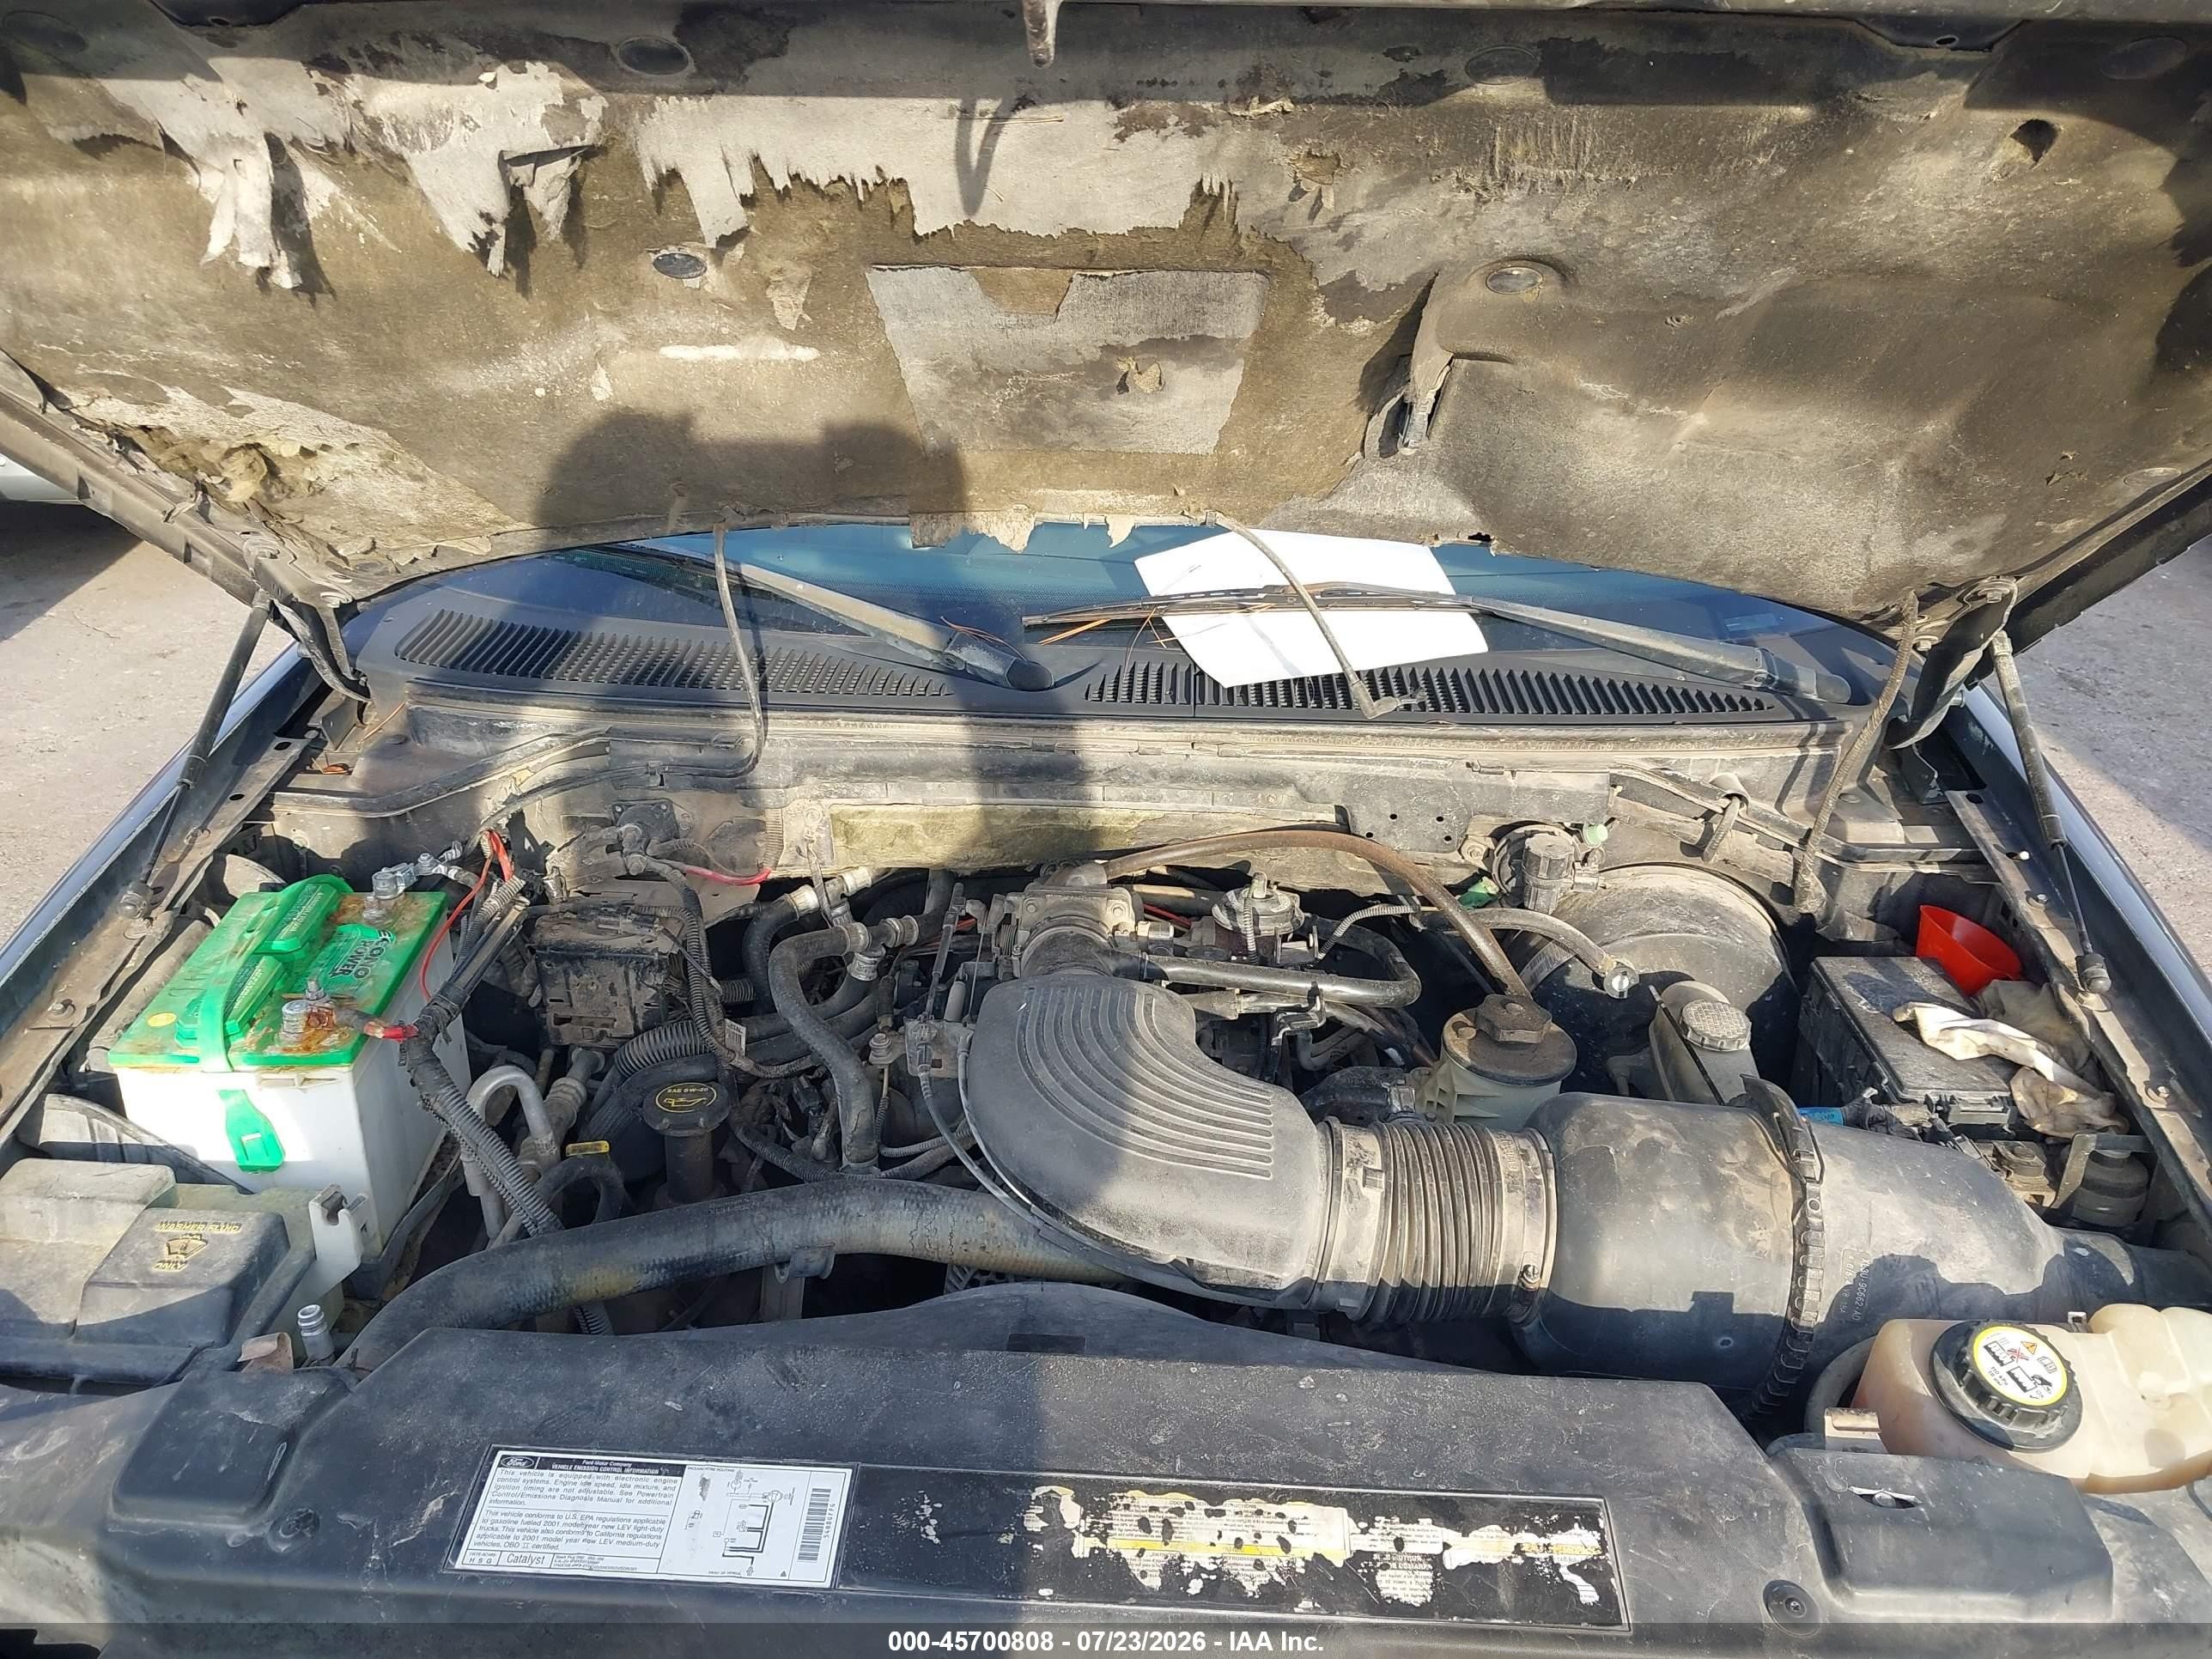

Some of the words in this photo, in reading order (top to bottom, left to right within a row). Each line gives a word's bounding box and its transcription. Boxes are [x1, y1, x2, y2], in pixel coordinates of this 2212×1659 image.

[329, 939, 377, 979] POWER
[155, 1221, 207, 1231] WASHER
[208, 1222, 242, 1233] FLUID
[152, 1260, 188, 1272] ONLY
[615, 1474, 650, 1483] electronic
[491, 1491, 556, 1500] Control/Emissions
[633, 1525, 665, 1534] light-duty
[616, 1540, 660, 1548] medium-duty
[507, 1553, 545, 1565] Catalyst
